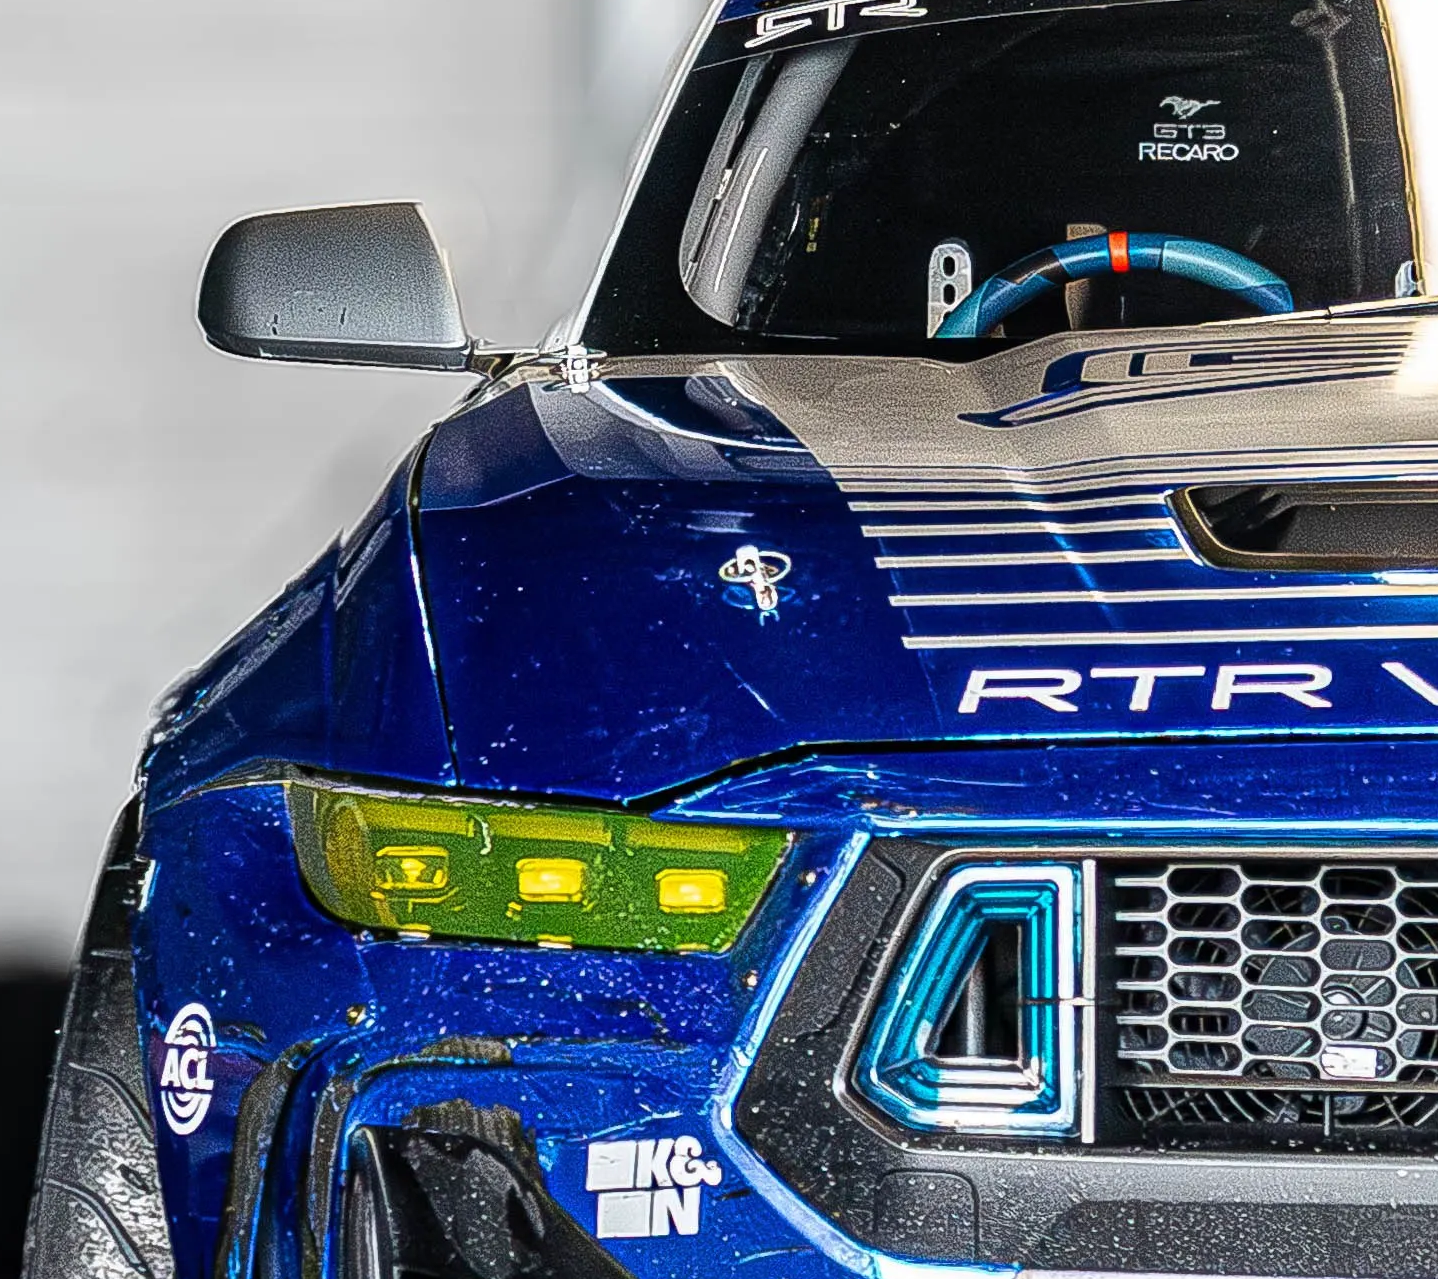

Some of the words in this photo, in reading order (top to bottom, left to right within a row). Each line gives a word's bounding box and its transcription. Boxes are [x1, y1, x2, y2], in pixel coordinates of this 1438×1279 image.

[1153, 123, 1226, 140] GT3
[1138, 142, 1240, 162] RECARO
[958, 663, 1333, 714] RTR
